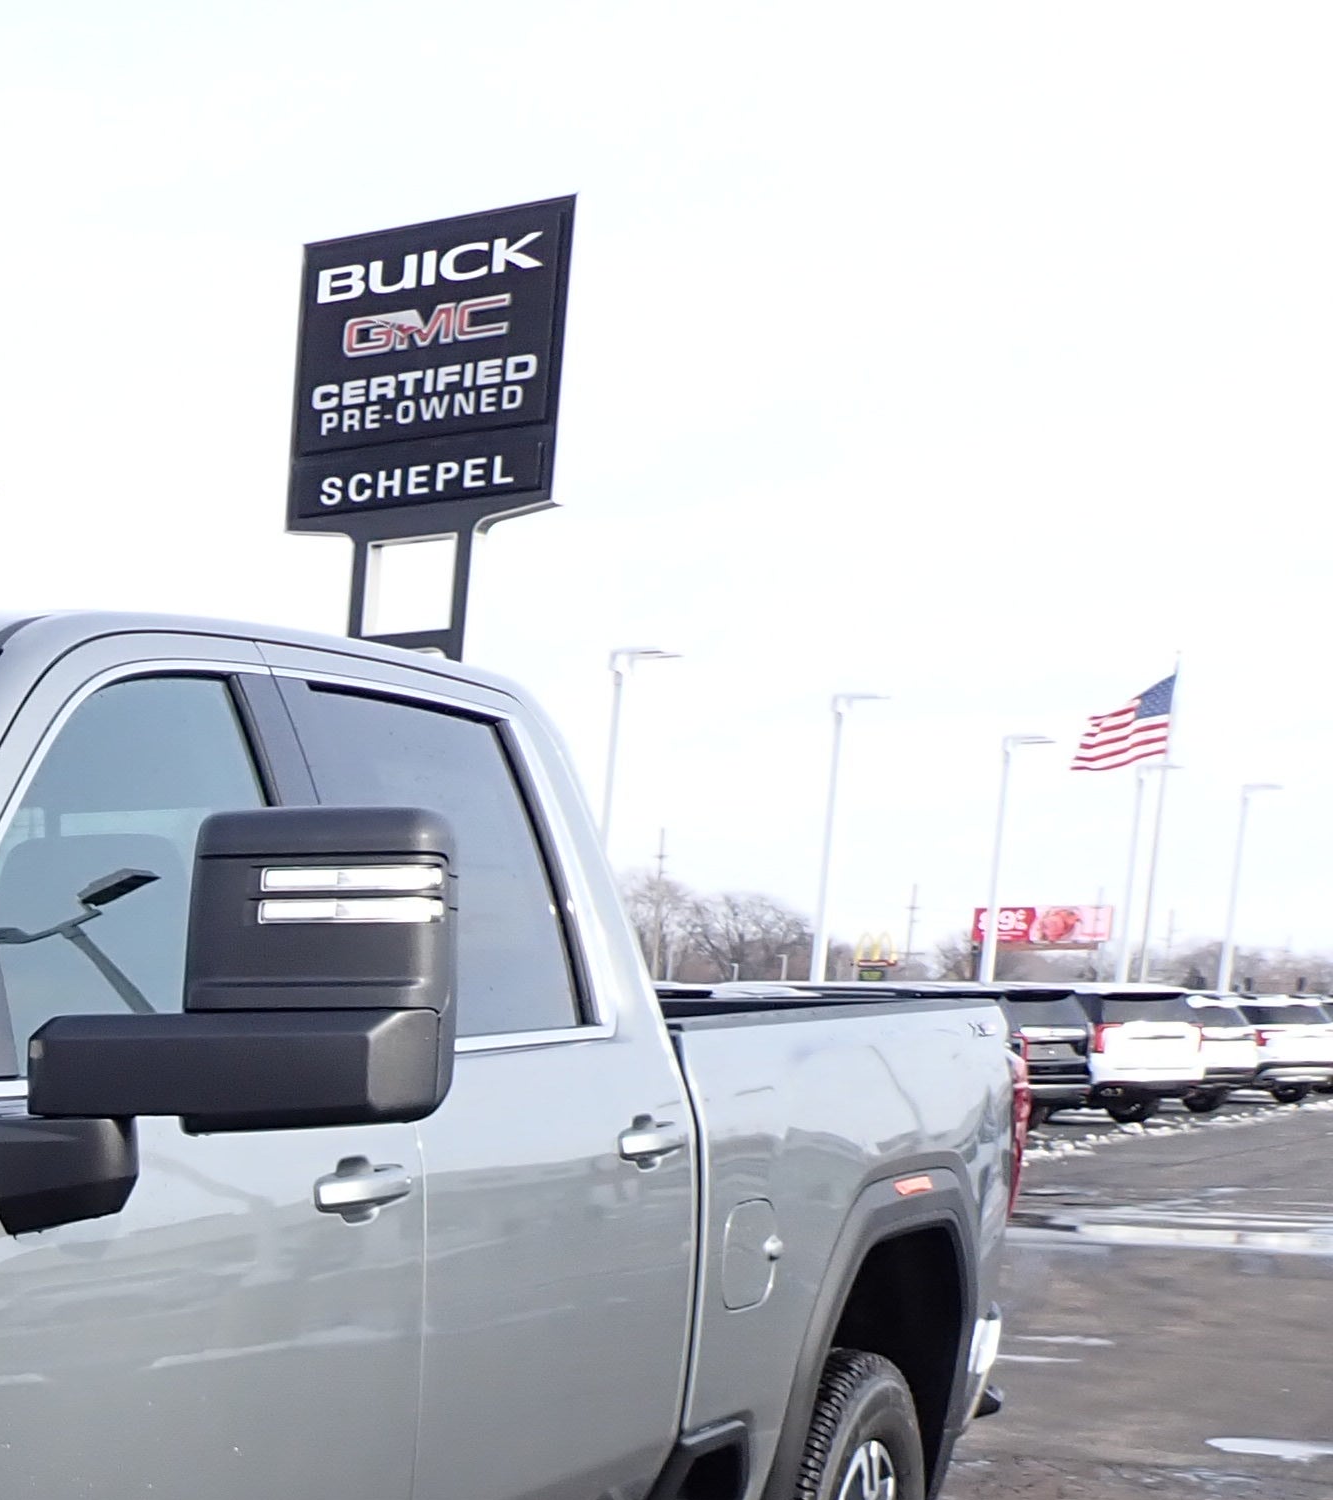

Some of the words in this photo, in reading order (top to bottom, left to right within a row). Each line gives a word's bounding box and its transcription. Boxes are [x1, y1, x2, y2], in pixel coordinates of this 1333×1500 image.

[316, 230, 544, 304] BUICK
[343, 293, 511, 358] GMC
[311, 353, 537, 410] CERTIFIED
[320, 384, 524, 436] PRE-OWNED
[319, 454, 514, 506] SCHEPEL
